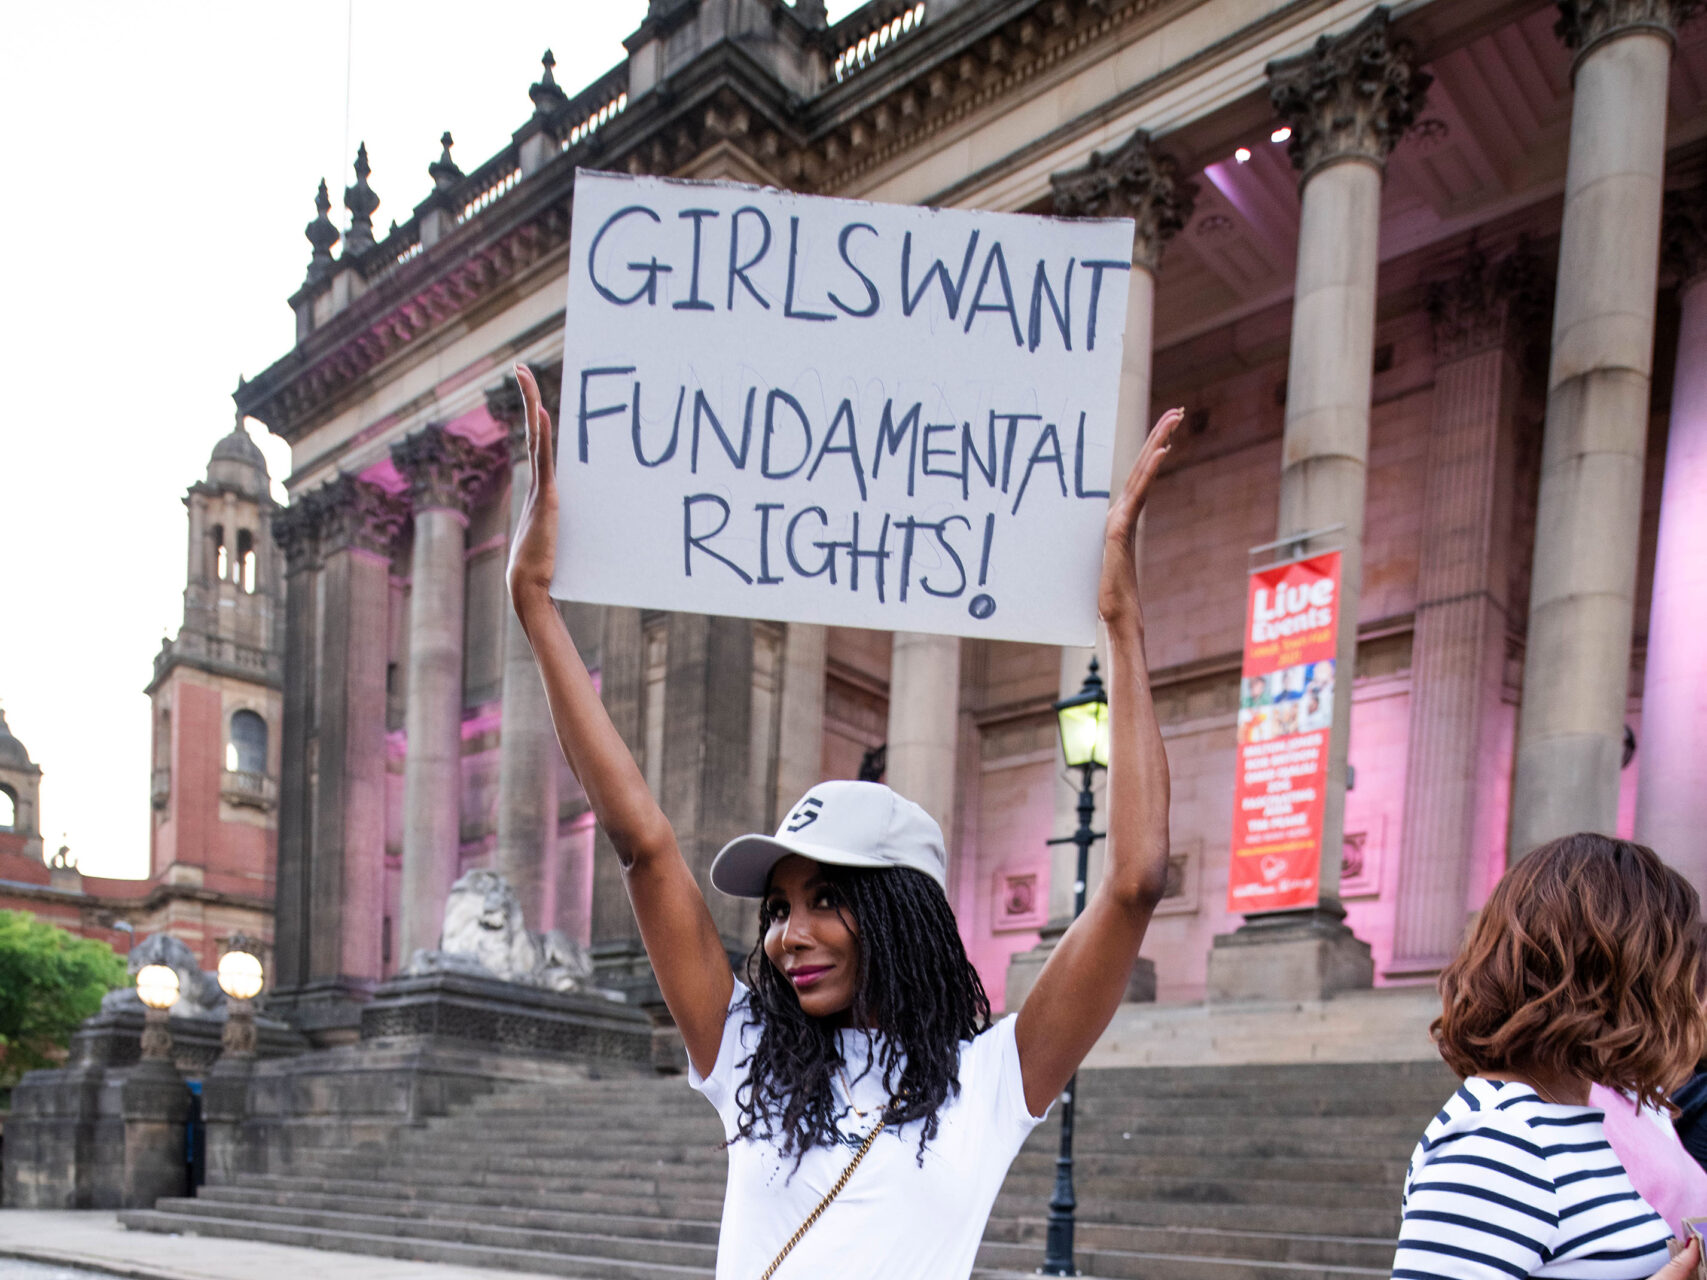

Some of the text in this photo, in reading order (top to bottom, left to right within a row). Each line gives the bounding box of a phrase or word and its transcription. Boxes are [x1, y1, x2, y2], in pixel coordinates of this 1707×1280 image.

[587, 205, 1132, 352] GIRLS WANT
[577, 366, 1111, 515] FUNDAMENTAL
[683, 493, 997, 620] RIGHTS!
[1253, 578, 1335, 620] Live
[1252, 607, 1331, 643] Events
